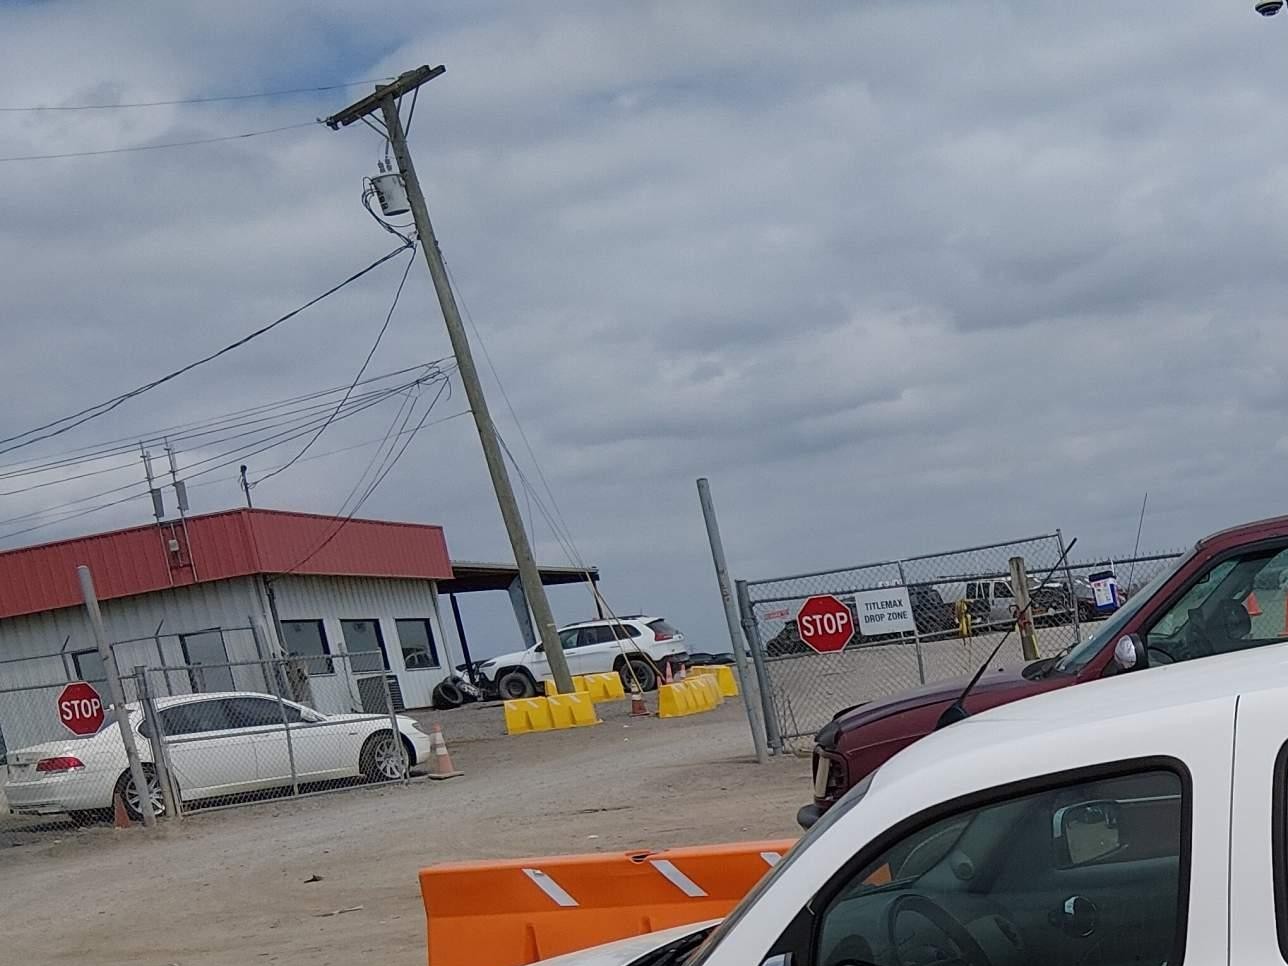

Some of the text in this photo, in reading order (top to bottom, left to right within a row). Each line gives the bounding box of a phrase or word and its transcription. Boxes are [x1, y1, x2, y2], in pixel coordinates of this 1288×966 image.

[864, 599, 904, 611] TITLEMAX
[802, 612, 848, 637] STOP
[864, 611, 908, 624] DROP ZONE
[61, 698, 100, 720] STOP
